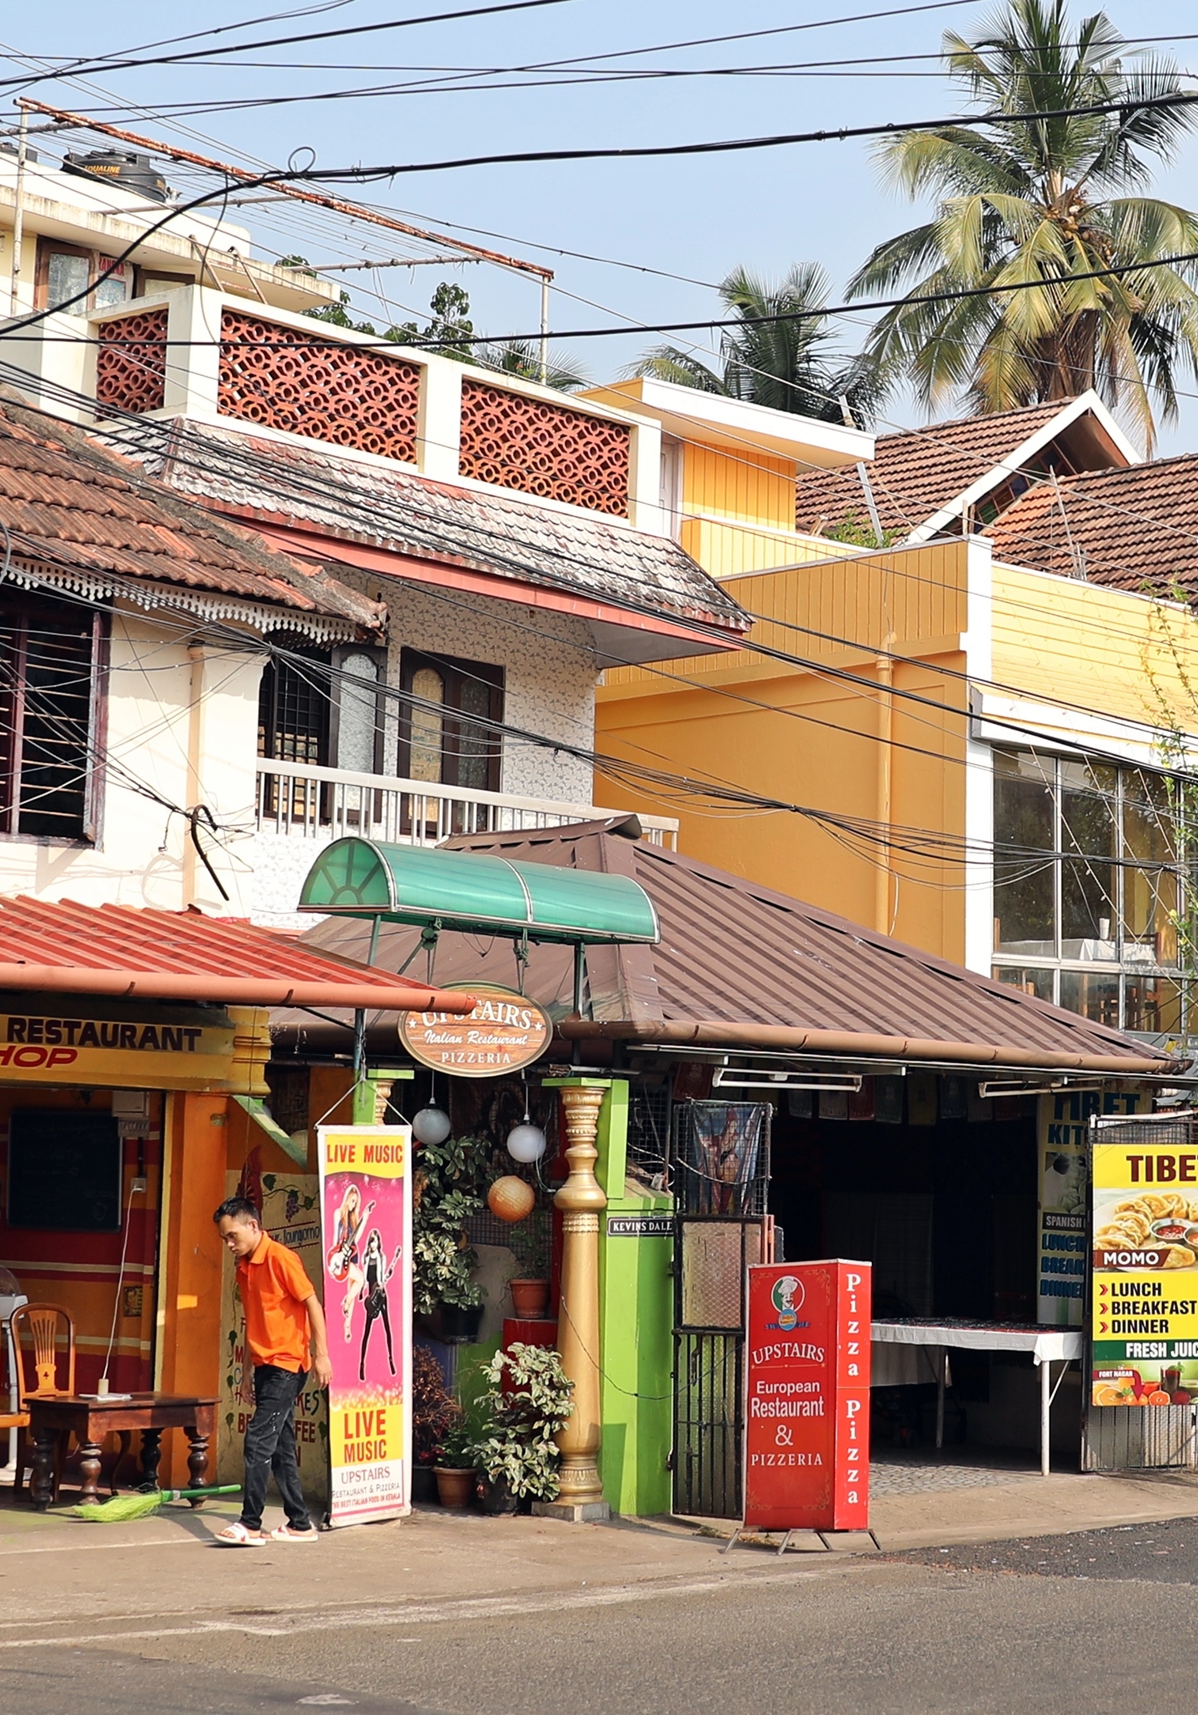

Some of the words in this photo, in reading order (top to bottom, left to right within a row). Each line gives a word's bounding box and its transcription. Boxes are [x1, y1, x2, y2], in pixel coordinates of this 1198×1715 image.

[421, 1000, 532, 1031] UTAIRS
[7, 1016, 202, 1052] RESTAURANT
[424, 1029, 463, 1045] Italian
[467, 1030, 528, 1046] Restaurant
[441, 1052, 511, 1064] PIZZERIA
[1047, 1124, 1089, 1146] KIT
[327, 1144, 356, 1163] LIVE
[363, 1144, 403, 1163] MUSIC
[1126, 1155, 1198, 1183] TIBE
[613, 1222, 647, 1232] KEVINS
[1045, 1215, 1083, 1229] SPANISH
[1103, 1251, 1159, 1265] MOMO
[1111, 1282, 1162, 1297] LUNCH
[1111, 1300, 1197, 1315] BREAKFAST
[846, 1273, 862, 1376] Pizza
[1111, 1319, 1169, 1334] DINNER
[752, 1342, 825, 1365] UPSTAIRS
[1126, 1342, 1167, 1358] FRESH
[756, 1380, 820, 1396] European
[751, 1396, 825, 1418] Restaurant
[344, 1409, 386, 1440] LIVE
[775, 1424, 793, 1446] &
[344, 1439, 387, 1463] MUSIC
[751, 1453, 823, 1466] PIZZERIA
[846, 1400, 861, 1504] Pizza
[341, 1466, 391, 1484] UPSTAIRS
[376, 1482, 400, 1492] PIZZERIA
